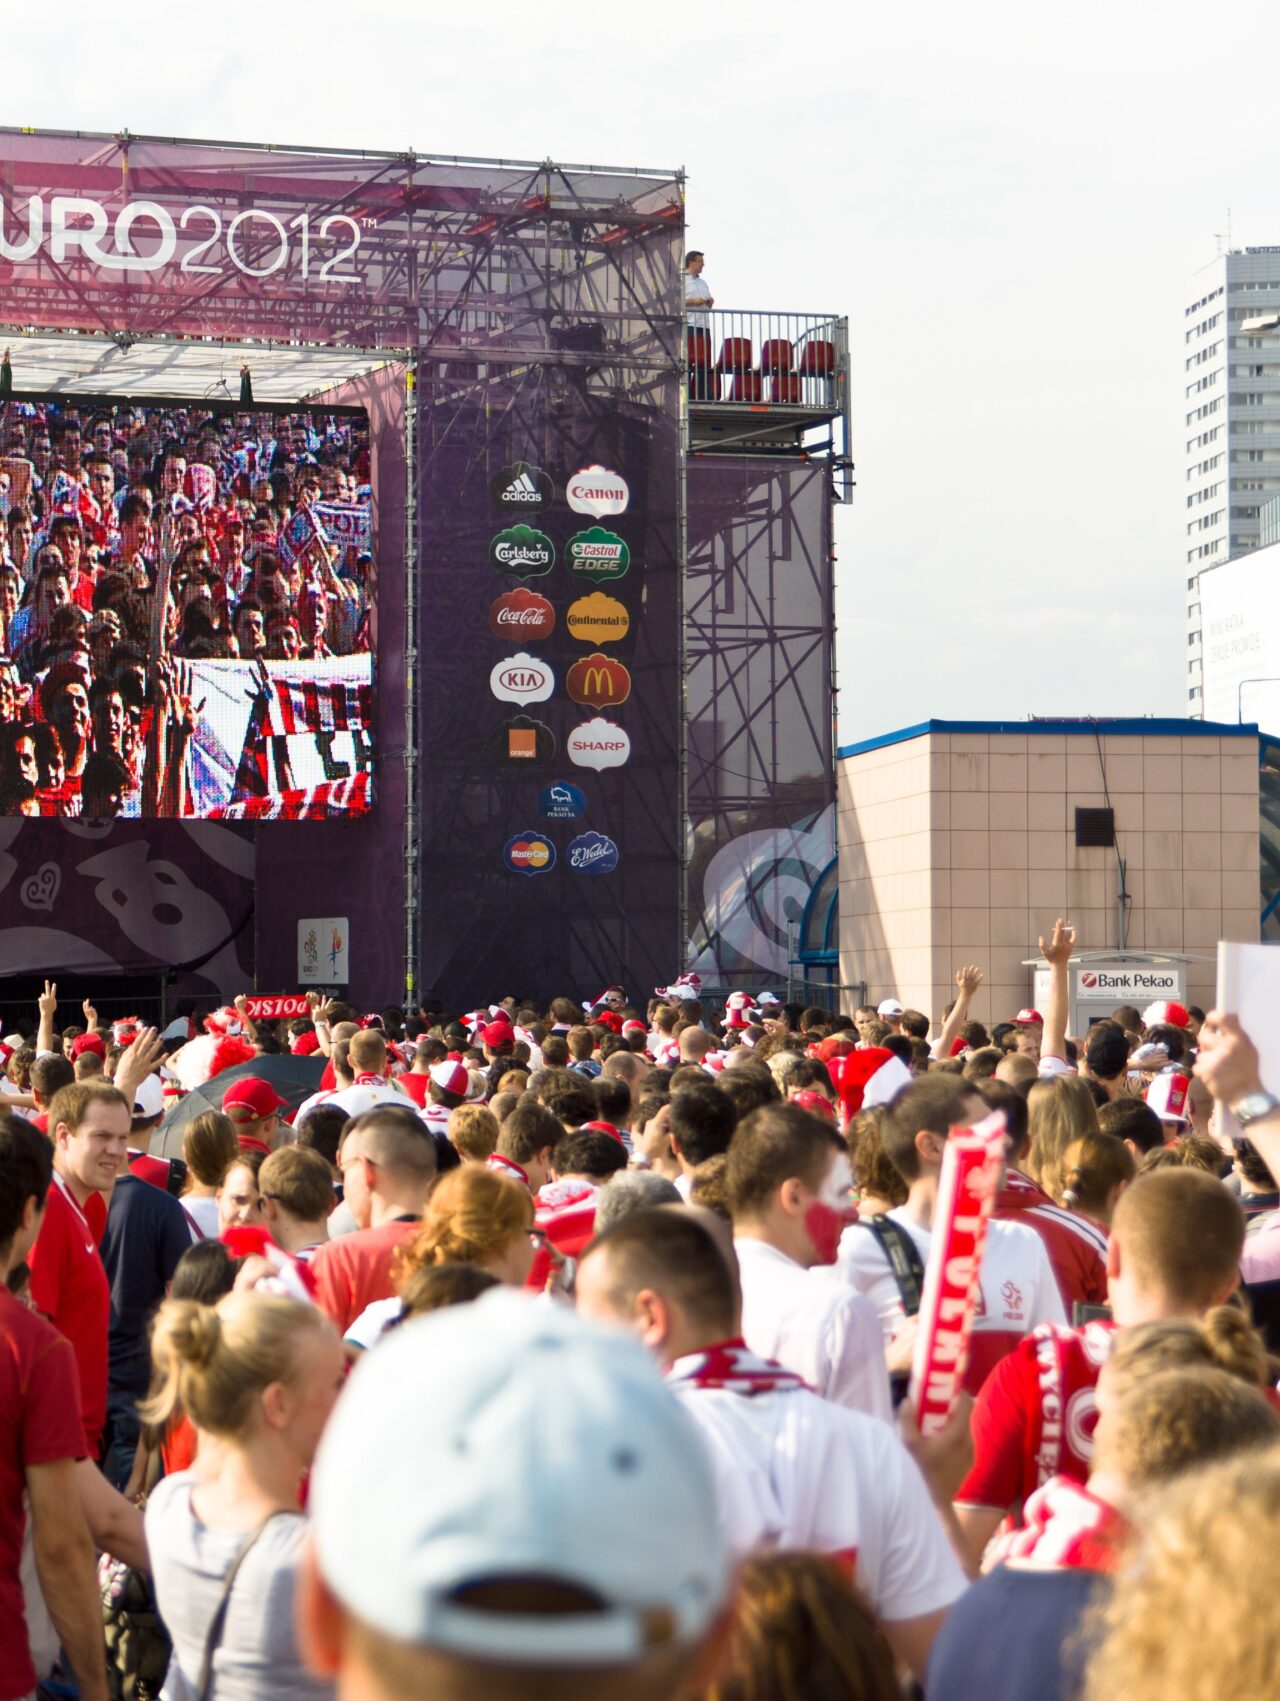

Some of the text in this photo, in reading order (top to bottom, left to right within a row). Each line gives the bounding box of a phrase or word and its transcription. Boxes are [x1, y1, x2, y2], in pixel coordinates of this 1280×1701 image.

[502, 490, 542, 502] adidas
[572, 486, 624, 501] Canon
[495, 542, 549, 565] Carlsberg
[583, 544, 620, 557] Castrol
[573, 559, 620, 571] EDGE
[497, 607, 546, 625] Coca-Cola
[568, 615, 620, 627] Continental
[508, 673, 538, 686] KIA
[572, 741, 625, 751] SHARP
[511, 850, 550, 859] MasterCard
[1098, 973, 1174, 988] Bank Pekao
